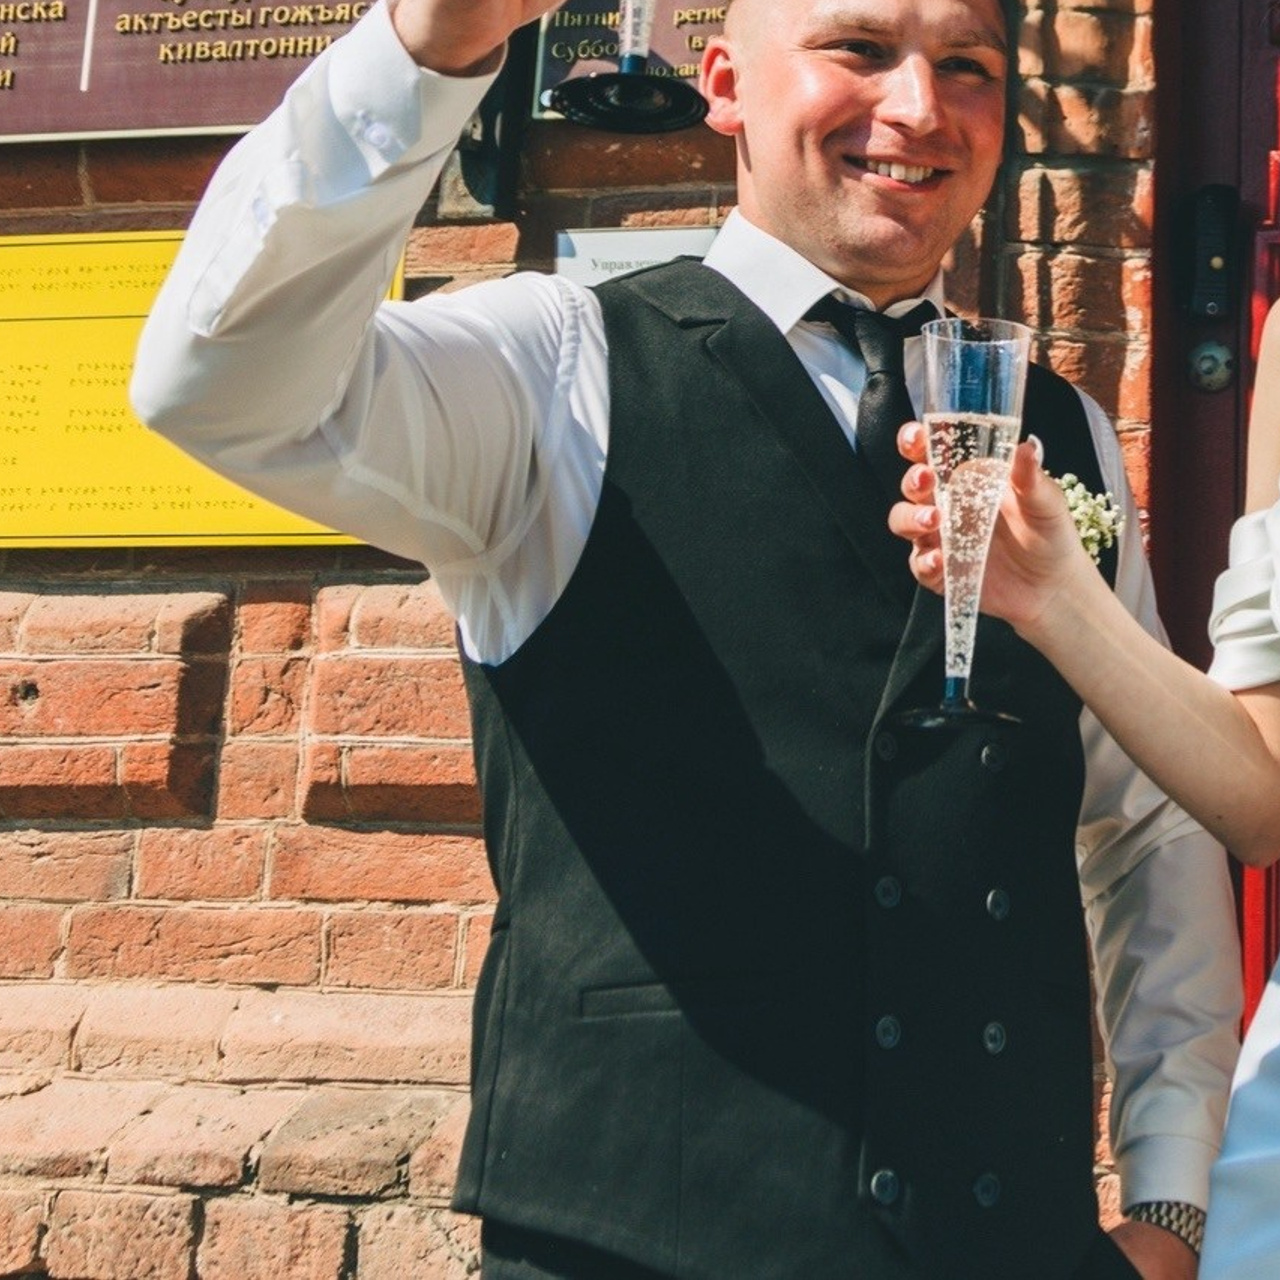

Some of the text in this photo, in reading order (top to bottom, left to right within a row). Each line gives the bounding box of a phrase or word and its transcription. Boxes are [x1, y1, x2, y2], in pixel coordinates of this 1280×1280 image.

[115, 1, 370, 33] актъесты гожъяс
[555, 11, 621, 28] Пятни
[158, 34, 334, 63] кивалтонни
[552, 40, 619, 62] Суббо
